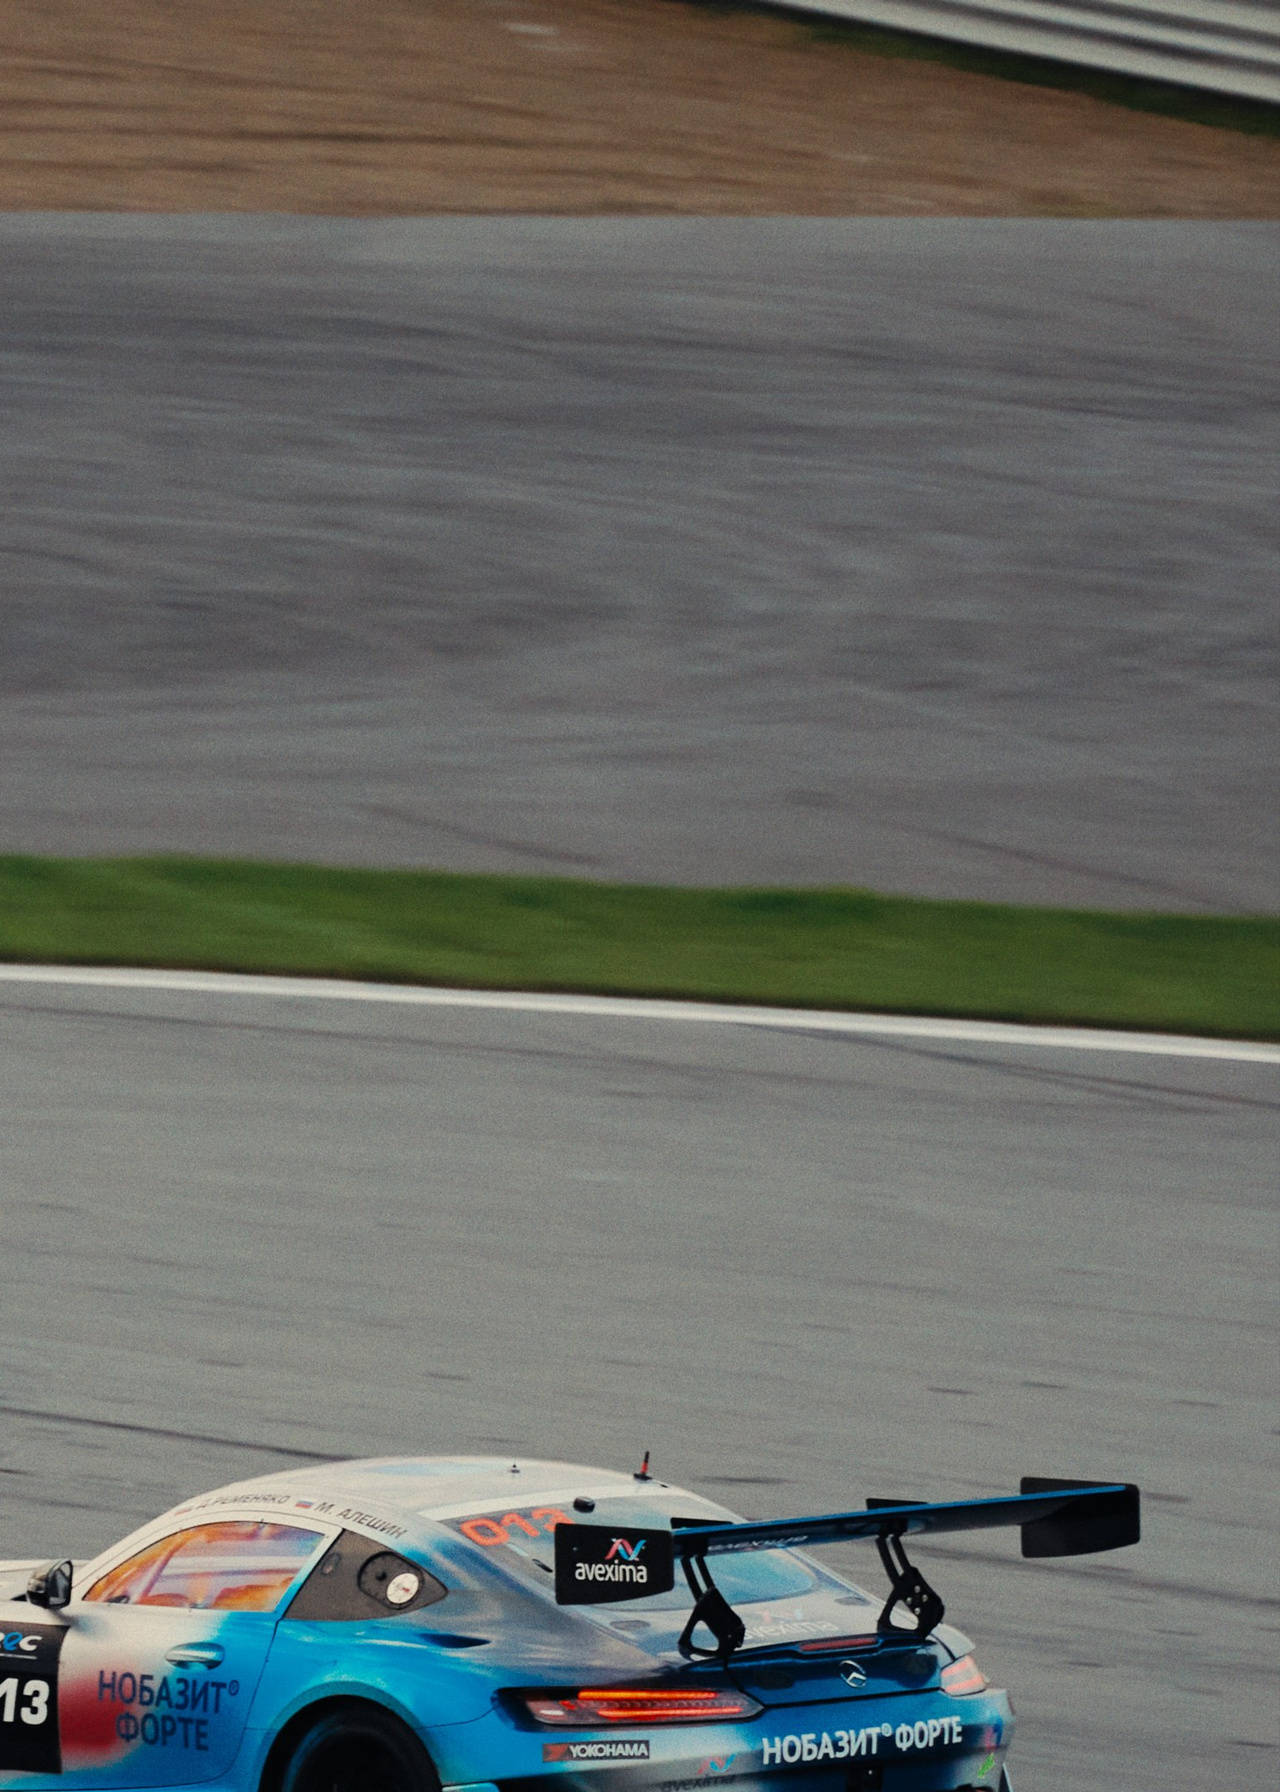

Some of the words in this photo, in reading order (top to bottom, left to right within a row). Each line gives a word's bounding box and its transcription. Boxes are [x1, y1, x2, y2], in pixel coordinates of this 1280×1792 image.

[336, 1508, 407, 1539] АЛЕШИН
[575, 1559, 648, 1583] avexima
[115, 1711, 209, 1751] ФОРТЕ
[894, 1716, 962, 1751] ФОРТЕ
[569, 1743, 649, 1758] YOKOHAMA
